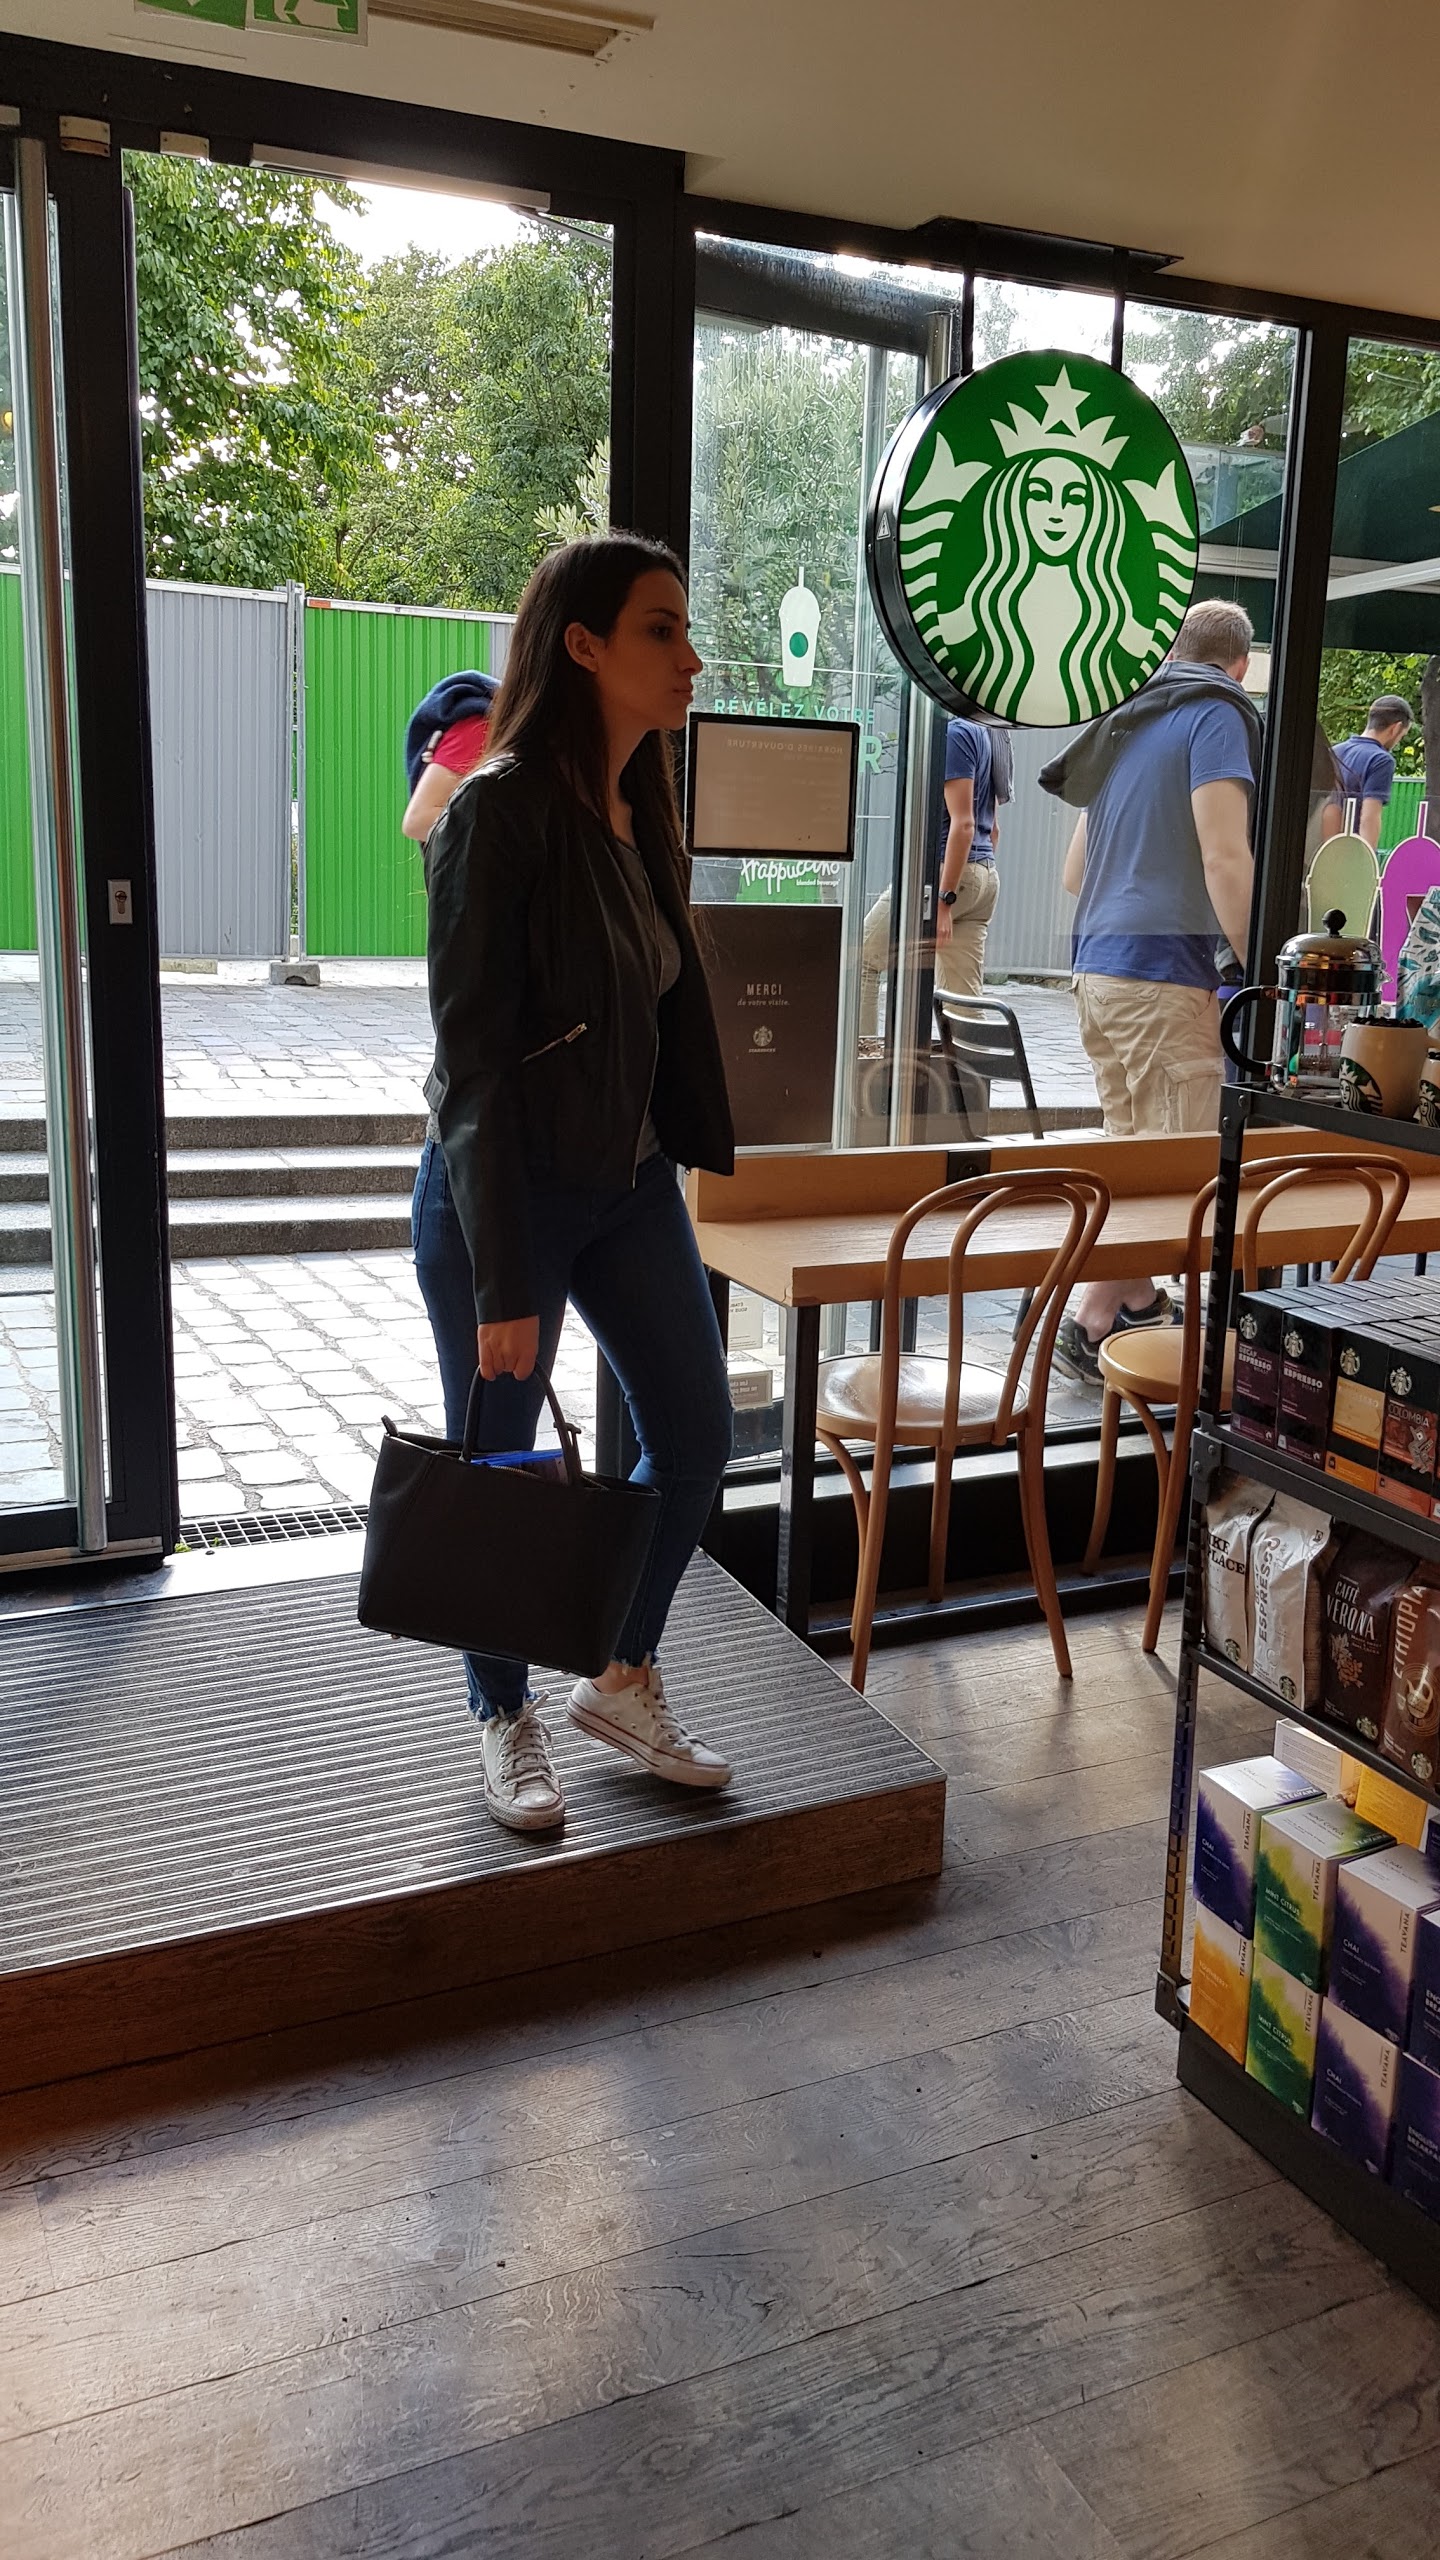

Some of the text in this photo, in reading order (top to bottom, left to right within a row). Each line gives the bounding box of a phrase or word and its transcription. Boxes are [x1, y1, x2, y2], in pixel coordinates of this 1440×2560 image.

[714, 695, 875, 725] RÉVÉLEZ VOTRE
[737, 998, 745, 1007] de
[748, 999, 767, 1007] votre
[746, 983, 783, 996] MERCI
[1238, 1353, 1272, 1372] ESPRESSO
[1283, 1366, 1323, 1389] ESPRESSO
[1387, 1403, 1430, 1428] COLOMBIA
[1207, 1532, 1230, 1556] IKE
[1334, 1580, 1360, 1604] CAFFÈ
[1326, 1594, 1375, 1641] VERONA
[1394, 1585, 1427, 1680] ETHIOPIA
[1282, 1787, 1319, 1800] TEAVANA
[1201, 1838, 1215, 1852] CHAI
[1243, 1813, 1252, 1850] TEAVANA
[1312, 1862, 1322, 1901] TEAVANA
[1265, 1887, 1280, 1901] MINT
[1280, 1898, 1301, 1916] CITRUS
[1343, 1938, 1360, 1954] CHAI
[1400, 1912, 1410, 1954] TEAVANA
[1239, 1941, 1248, 1977] TEAVANA
[1304, 1994, 1314, 2032] TEAVANA
[1258, 2014, 1272, 2028] MINT
[1272, 2027, 1293, 2046] CITRUS
[1326, 2068, 1342, 2085] CHAI
[1381, 2049, 1390, 2088] TEAVANA
[1407, 2134, 1440, 2163] BREAKFA
[1408, 2126, 1439, 2150] ENGLISH
